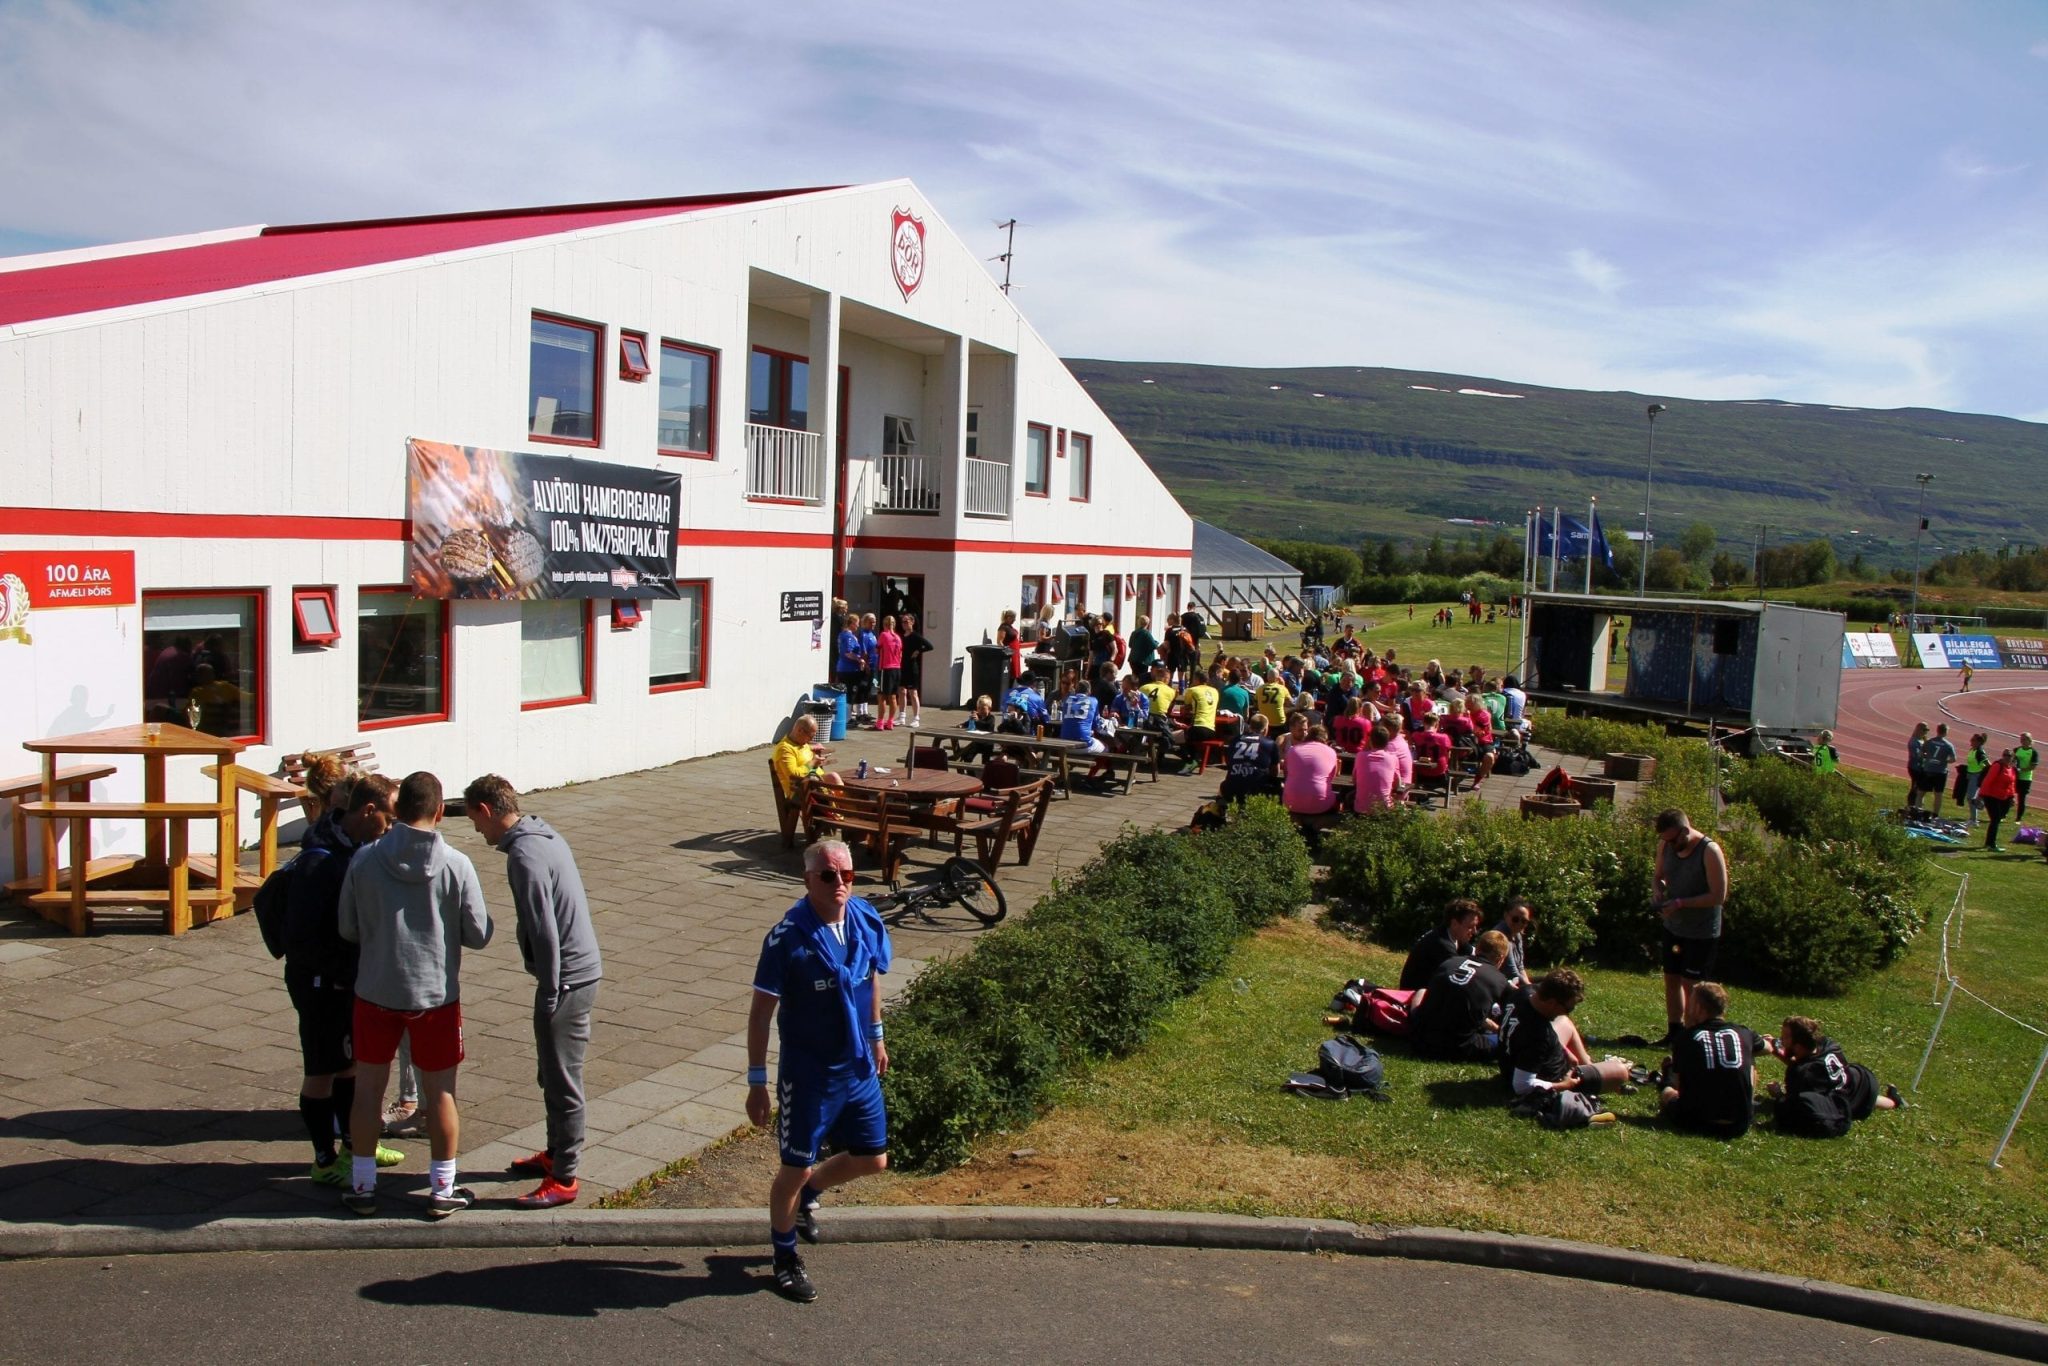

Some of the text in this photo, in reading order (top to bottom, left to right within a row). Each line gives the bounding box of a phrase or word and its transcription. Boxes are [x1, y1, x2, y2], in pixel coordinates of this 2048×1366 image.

[533, 477, 671, 524] ALVÖRU HAMBORGARAR
[551, 520, 579, 552] 100%
[46, 564, 111, 582] 100 ÁRA
[49, 586, 112, 598] AFMÆLI ÞÓRS
[1947, 648, 1994, 656] AKUREYRAR
[1149, 688, 1158, 701] 4
[1262, 688, 1280, 704] 52
[1064, 695, 1090, 719] 13
[1233, 742, 1260, 760] 24
[1933, 745, 1940, 758] 7
[1231, 763, 1256, 777] Skyr
[1448, 959, 1482, 985] 5
[1693, 1028, 1743, 1069] 10
[1824, 1053, 1847, 1090] 9
